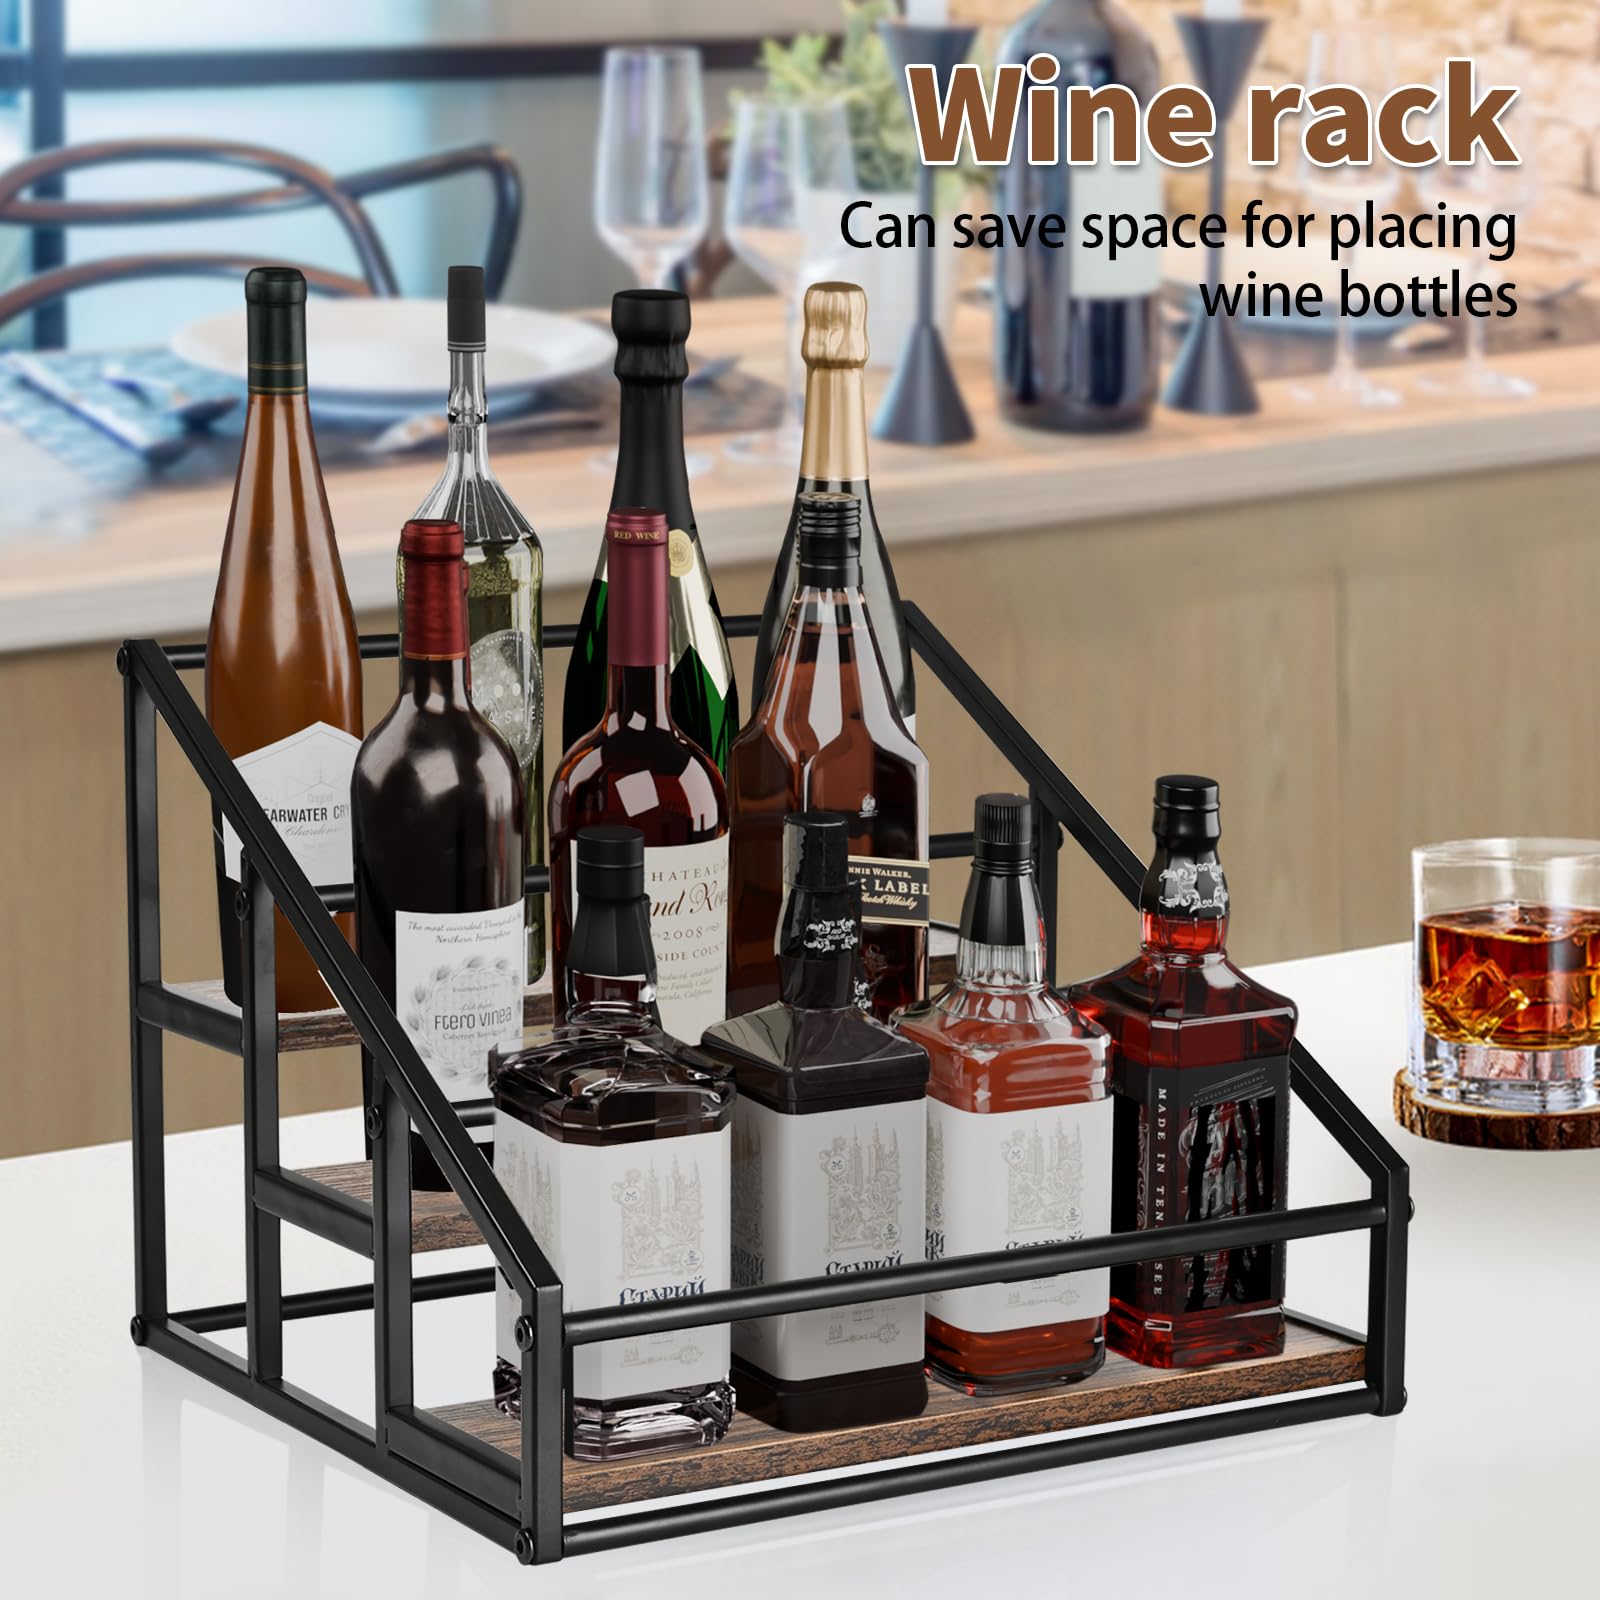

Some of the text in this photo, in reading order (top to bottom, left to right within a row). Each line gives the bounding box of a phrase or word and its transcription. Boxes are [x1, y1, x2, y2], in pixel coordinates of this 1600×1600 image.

[614, 530, 660, 540] RED WINE
[875, 879, 930, 896] LABEL
[1157, 1088, 1168, 1141] MADE
[1156, 1152, 1166, 1173] IN
